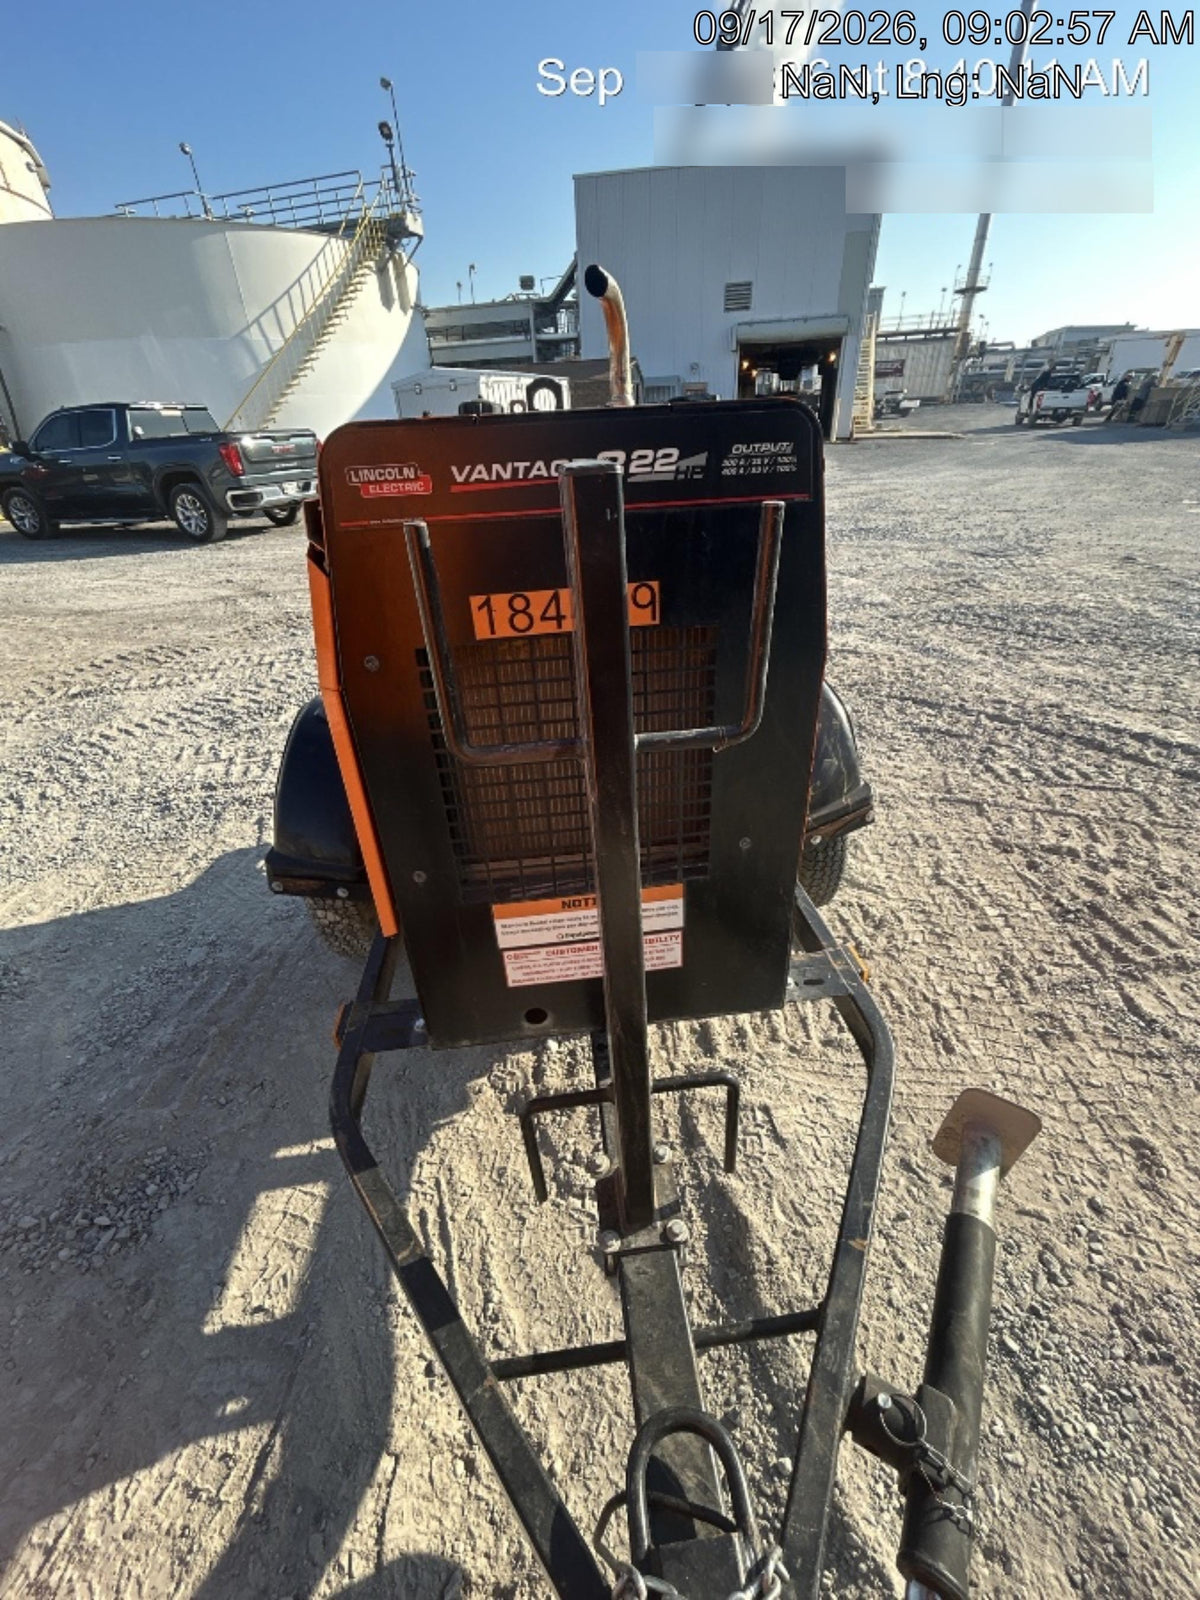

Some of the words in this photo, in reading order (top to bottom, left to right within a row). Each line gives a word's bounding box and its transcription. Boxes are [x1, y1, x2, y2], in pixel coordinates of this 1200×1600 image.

[731, 442, 791, 455] OUTPUT
[350, 466, 415, 483] LINCOLN
[450, 458, 571, 483] VANTAG
[368, 481, 425, 494] ELECTRIC
[545, 944, 599, 957] CUSTOMER
